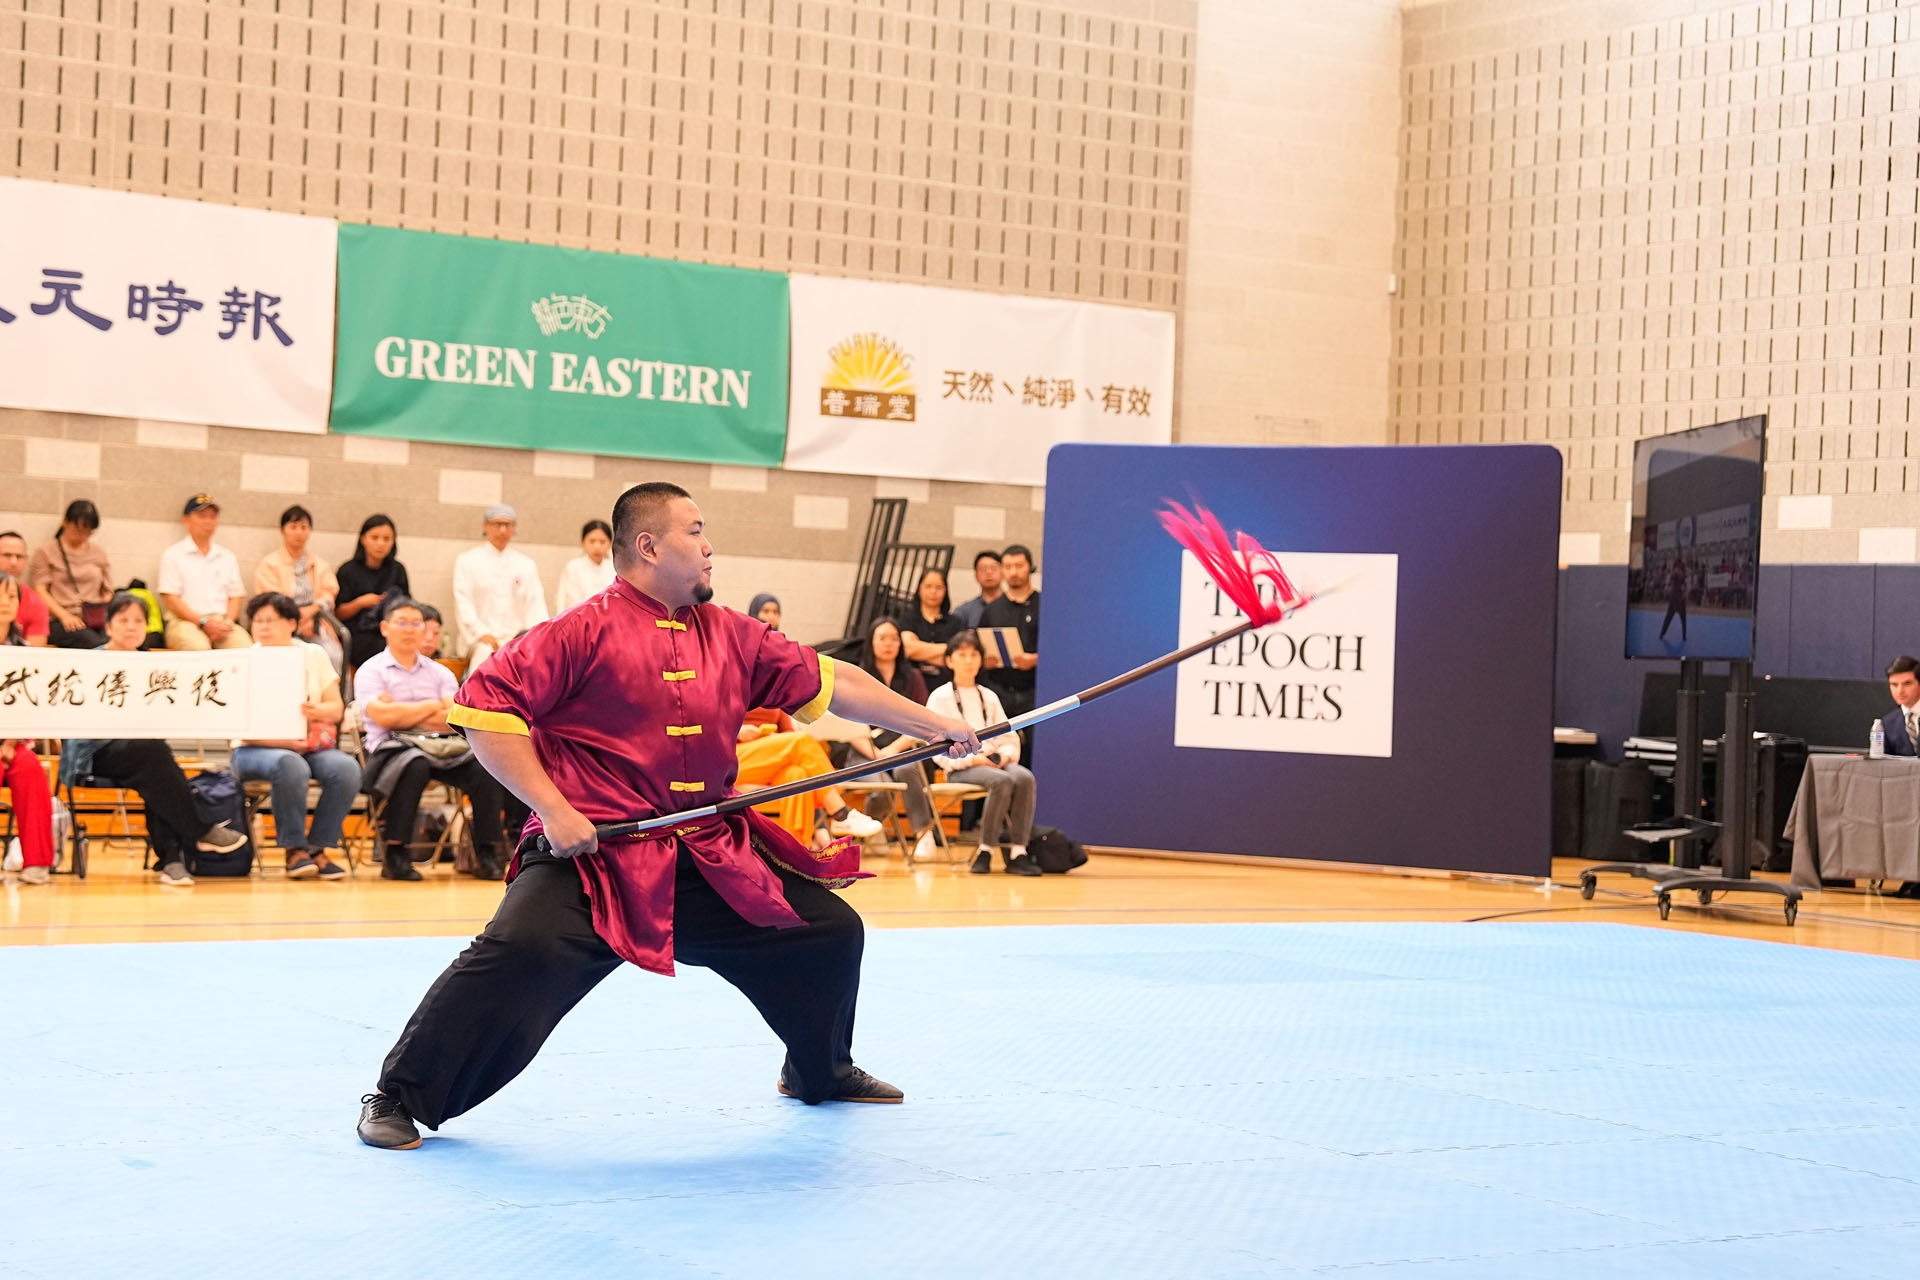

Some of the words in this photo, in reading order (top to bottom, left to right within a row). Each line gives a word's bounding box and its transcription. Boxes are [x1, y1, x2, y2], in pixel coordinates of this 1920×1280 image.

[0, 268, 294, 347] 元時報
[374, 336, 538, 390] GREEN
[549, 352, 752, 409] EASTERN
[1203, 680, 1343, 722] TIMES
